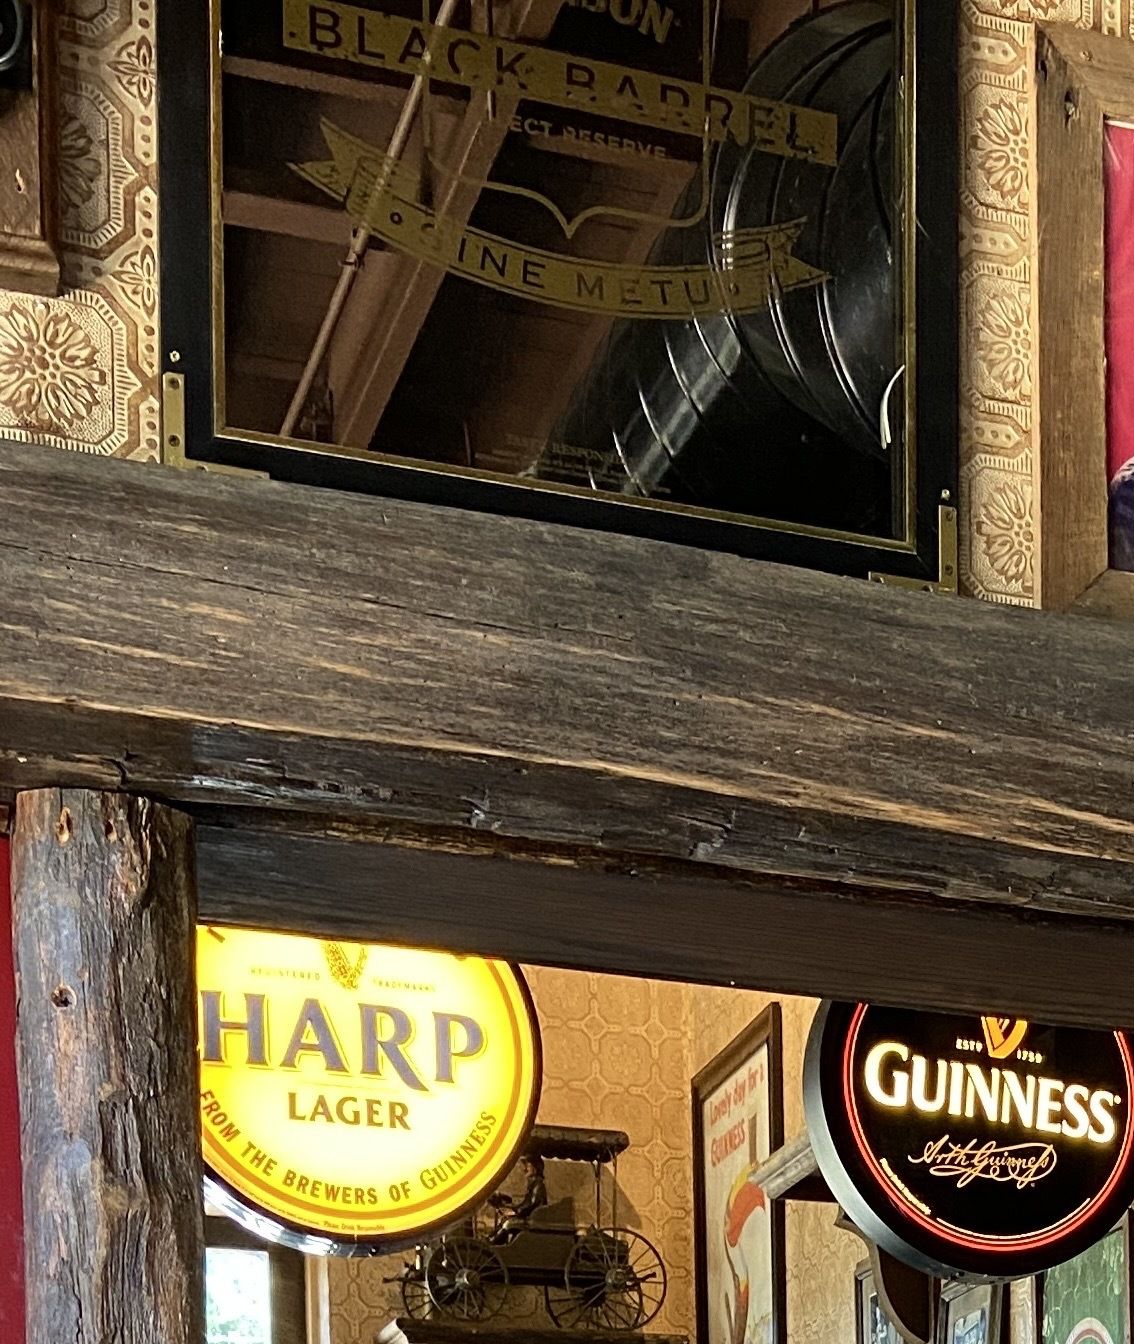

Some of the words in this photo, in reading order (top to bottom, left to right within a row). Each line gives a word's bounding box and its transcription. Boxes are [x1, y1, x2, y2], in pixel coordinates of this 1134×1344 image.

[309, 6, 527, 89] BLACK
[566, 62, 818, 155] BARREL
[562, 127, 667, 159] RESERVE
[200, 990, 485, 1092] HARP
[288, 1092, 412, 1131] LAGER
[864, 1042, 1115, 1143] GUINNESS
[200, 1090, 240, 1143] FROM
[241, 1141, 278, 1177] THE
[282, 1170, 378, 1206] BREWERS
[389, 1182, 413, 1203] OF
[419, 1110, 498, 1191] GUINNESS
